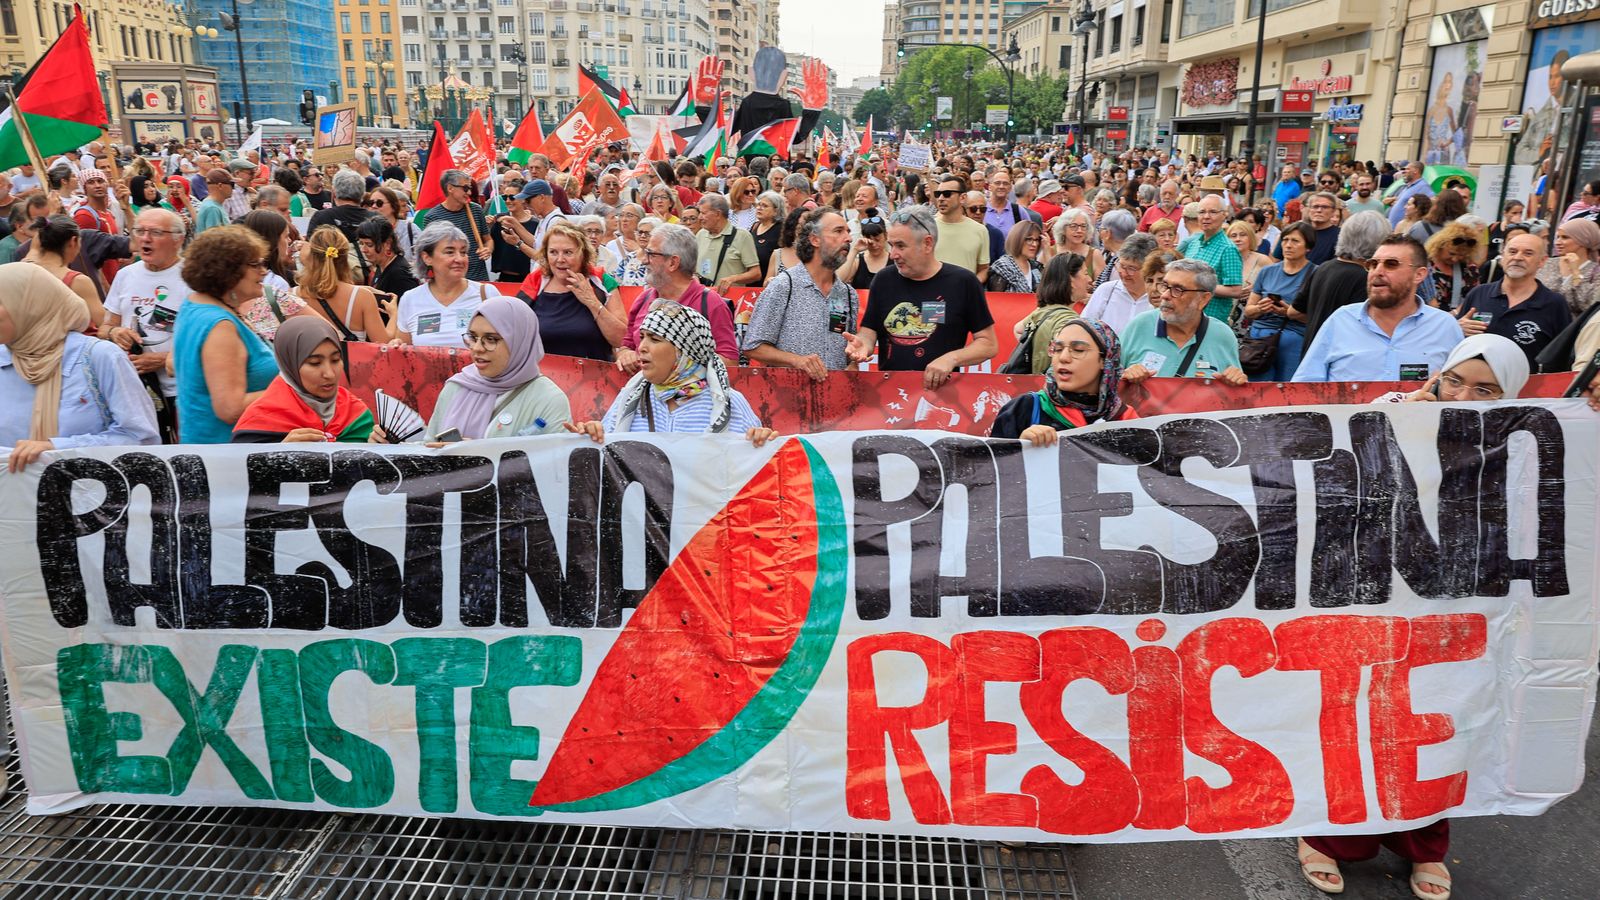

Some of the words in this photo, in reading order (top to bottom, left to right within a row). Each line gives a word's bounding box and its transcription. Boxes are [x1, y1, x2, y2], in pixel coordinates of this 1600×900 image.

[1538, 0, 1597, 18] GUESS
[131, 296, 155, 306] Free
[36, 440, 674, 631] PALESTINA
[852, 406, 1570, 620] PALESTINA
[57, 635, 583, 816] EXISTE
